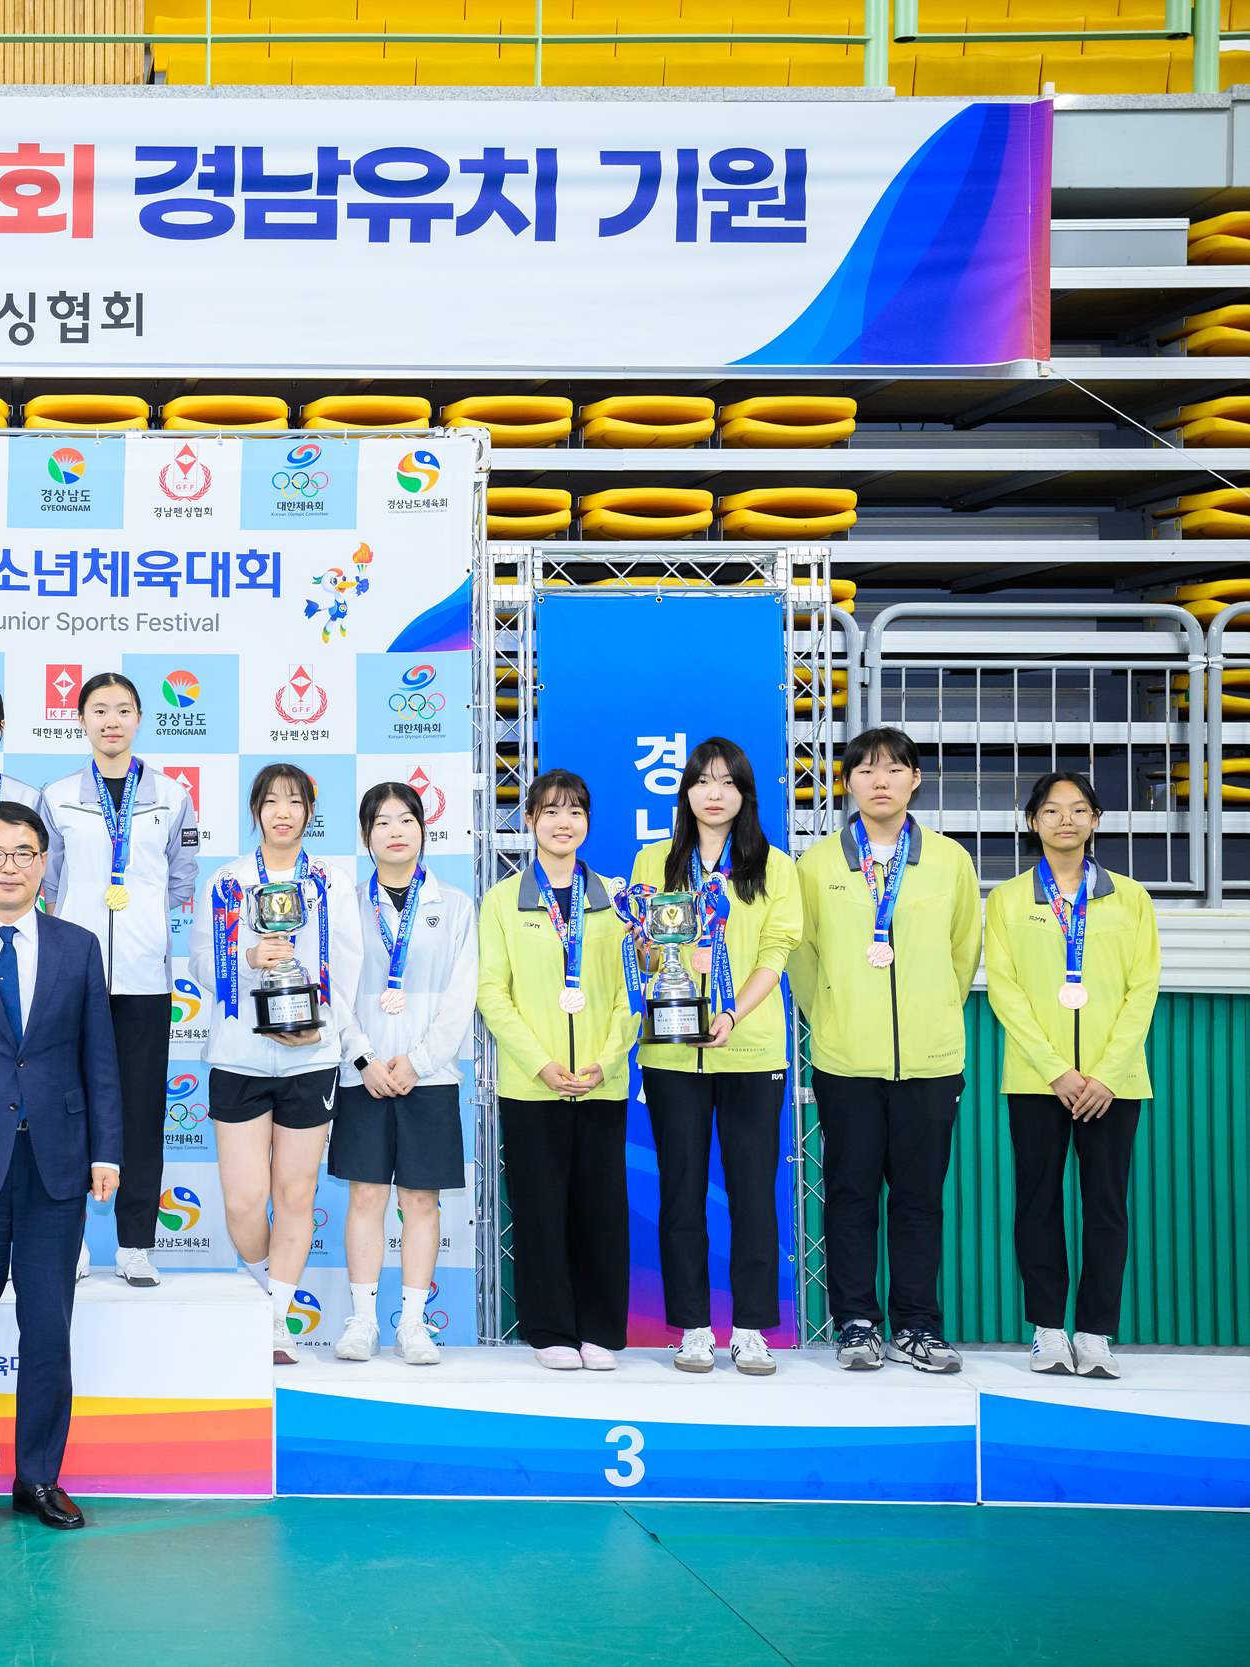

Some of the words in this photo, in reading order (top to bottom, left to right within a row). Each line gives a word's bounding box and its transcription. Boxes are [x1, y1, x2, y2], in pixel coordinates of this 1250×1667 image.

[135, 145, 557, 243] 경남유치
[599, 147, 807, 243] 기원
[41, 489, 91, 502] 경상남도
[41, 504, 91, 512] GYEONGNAM
[276, 501, 324, 511] 대한체육회
[387, 498, 448, 509] 경상남도체육회
[153, 507, 213, 518] 경남펜싱협회
[56, 612, 129, 635] Sports
[136, 613, 220, 632] Festival
[156, 713, 206, 726] 경상남도
[33, 728, 88, 739] 대한펜싱협
[156, 728, 206, 736] GYEONGNAM
[394, 723, 441, 734] 대한체육회
[270, 730, 330, 741] 경남펜싱협회
[169, 1028, 209, 1039] 남도체육회
[165, 1134, 202, 1144] 한체육회
[605, 1426, 646, 1487] 3
